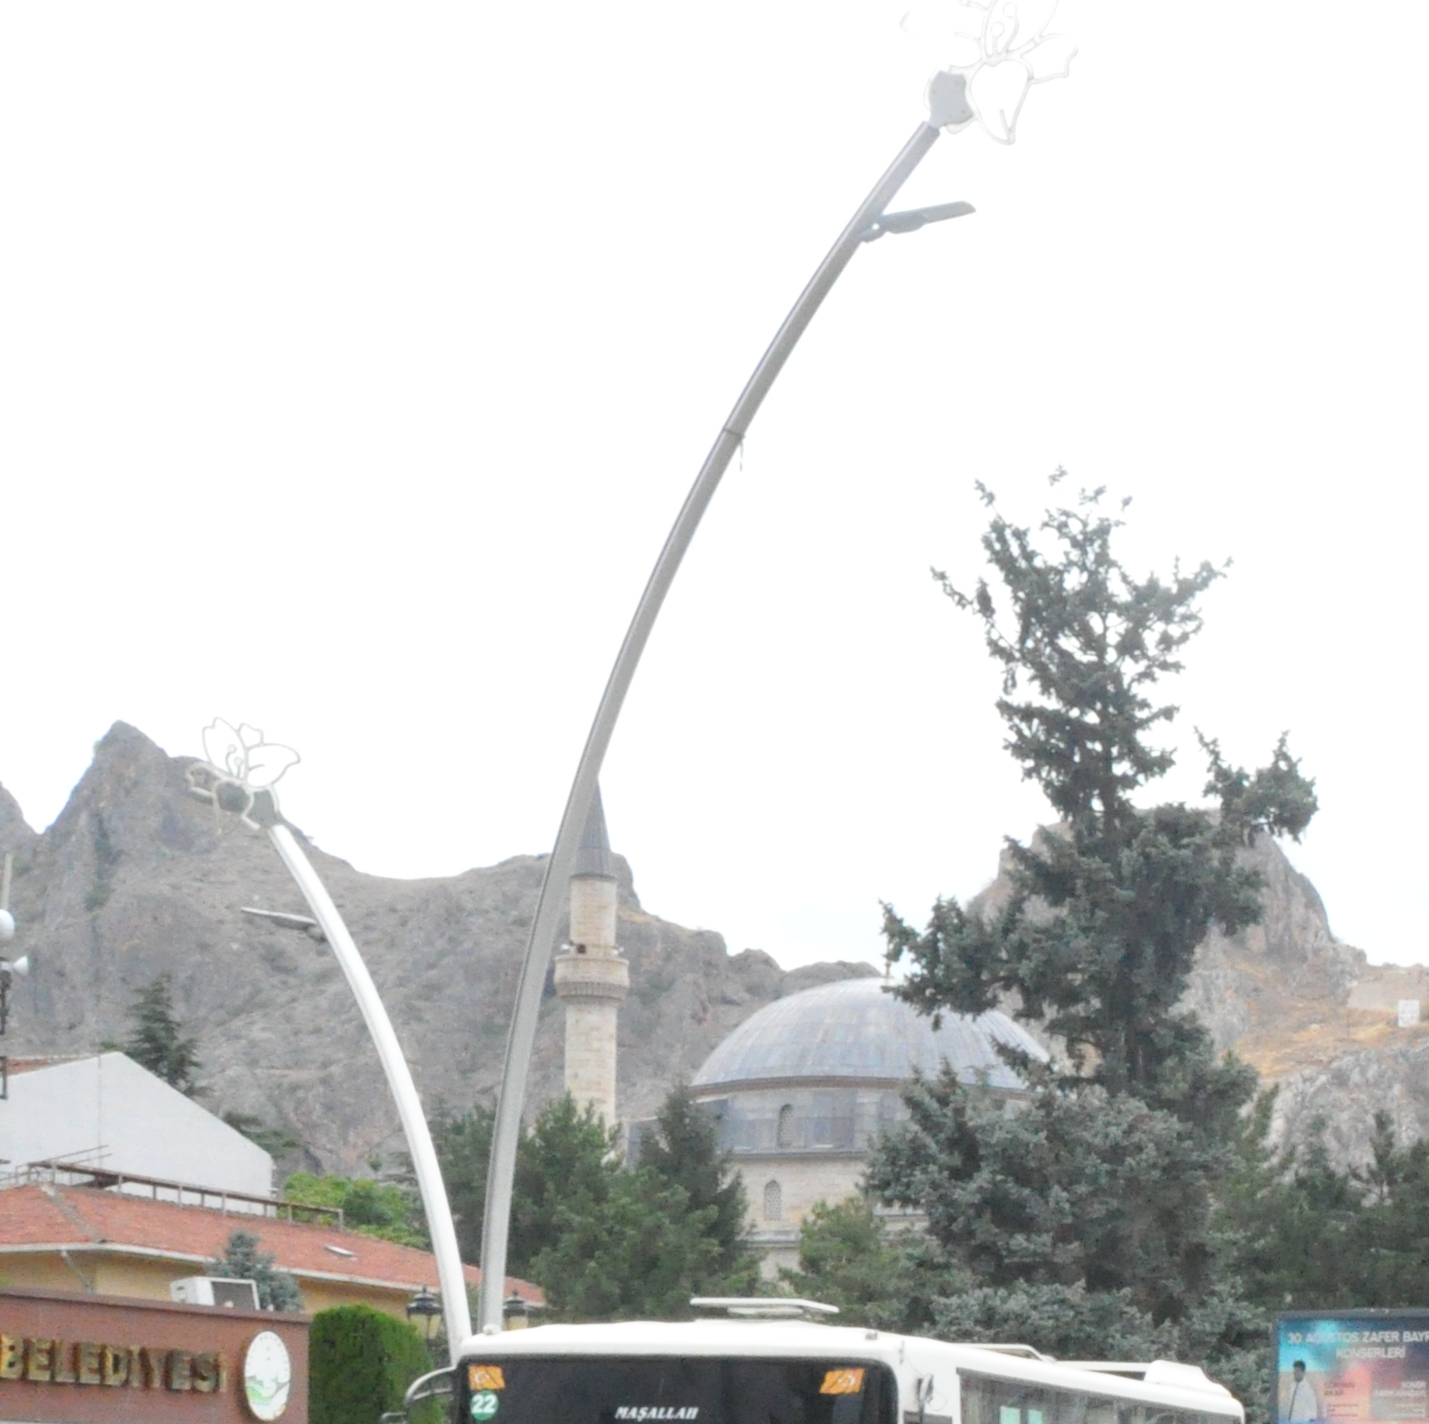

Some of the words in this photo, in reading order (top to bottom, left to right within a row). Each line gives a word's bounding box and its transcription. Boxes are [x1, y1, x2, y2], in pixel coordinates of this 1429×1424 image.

[1362, 1331, 1399, 1343] ZAFER
[1336, 1345, 1407, 1358] KONSERLERİ
[472, 1394, 497, 1413] 22
[614, 1406, 699, 1422] MAŞALLAH
